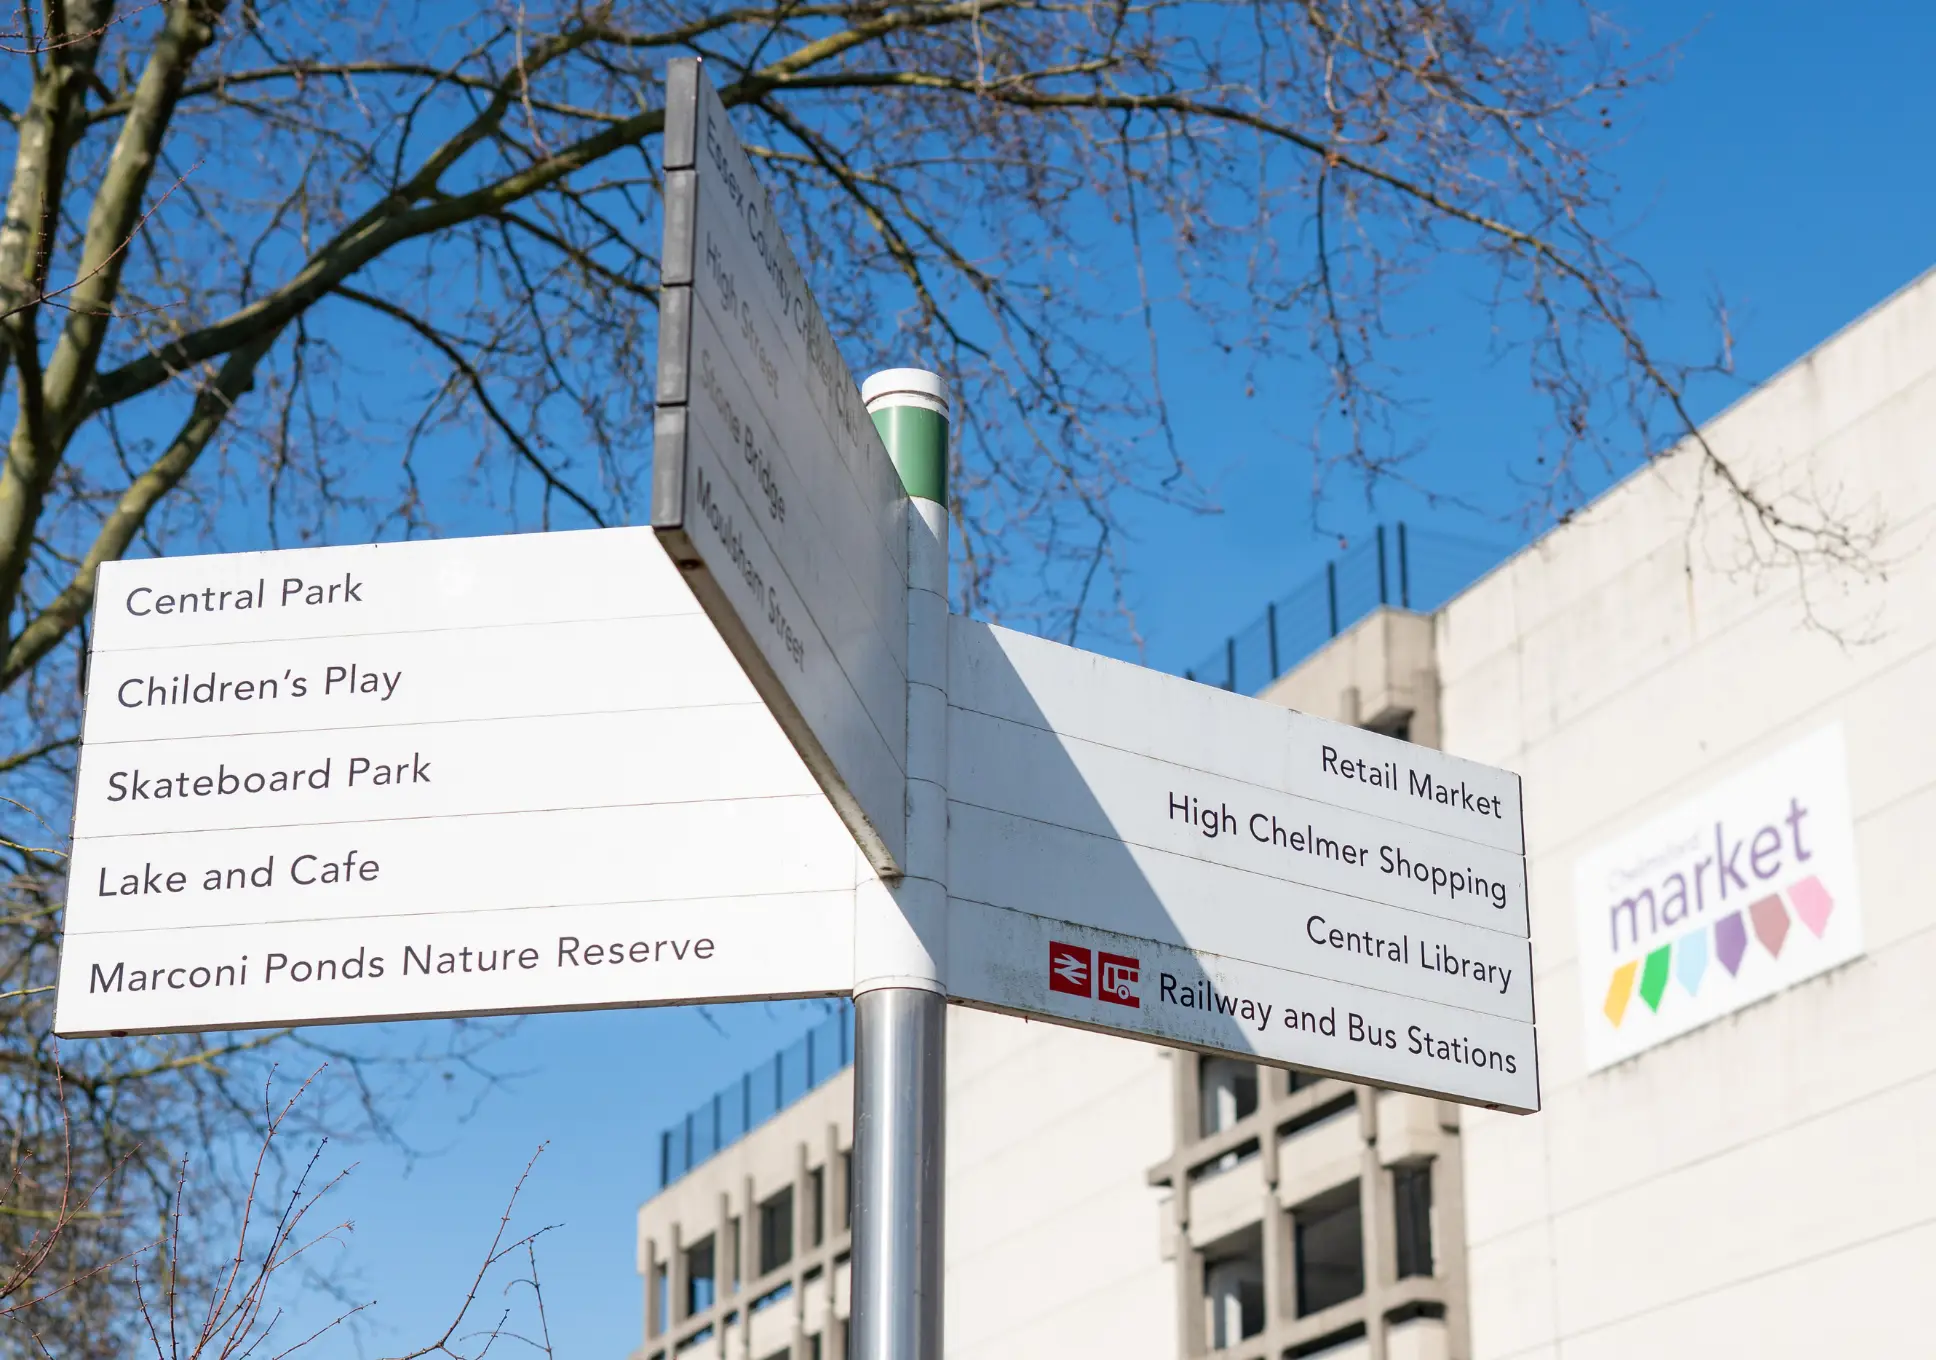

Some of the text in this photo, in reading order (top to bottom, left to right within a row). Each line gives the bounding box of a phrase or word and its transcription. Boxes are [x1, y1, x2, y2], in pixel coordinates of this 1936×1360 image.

[705, 120, 745, 218] Essex
[747, 201, 792, 315] County
[706, 230, 780, 401] High Street
[699, 348, 786, 525] Stone Bridge
[125, 572, 363, 617] Central Park
[696, 467, 805, 673] Moulsham Street
[117, 663, 403, 708] Children’s Play
[106, 752, 431, 802] Skateboard Park
[1322, 745, 1502, 819] Retail Market
[98, 850, 381, 898] Lake and Cafe
[1168, 791, 1507, 909] High Chelmer Shopping
[1610, 797, 1811, 952] market
[89, 934, 715, 994] Marconi Ponds Nature Reserve
[1306, 915, 1512, 995] Central Library
[1160, 972, 1517, 1075] Railway and Bus Stations
